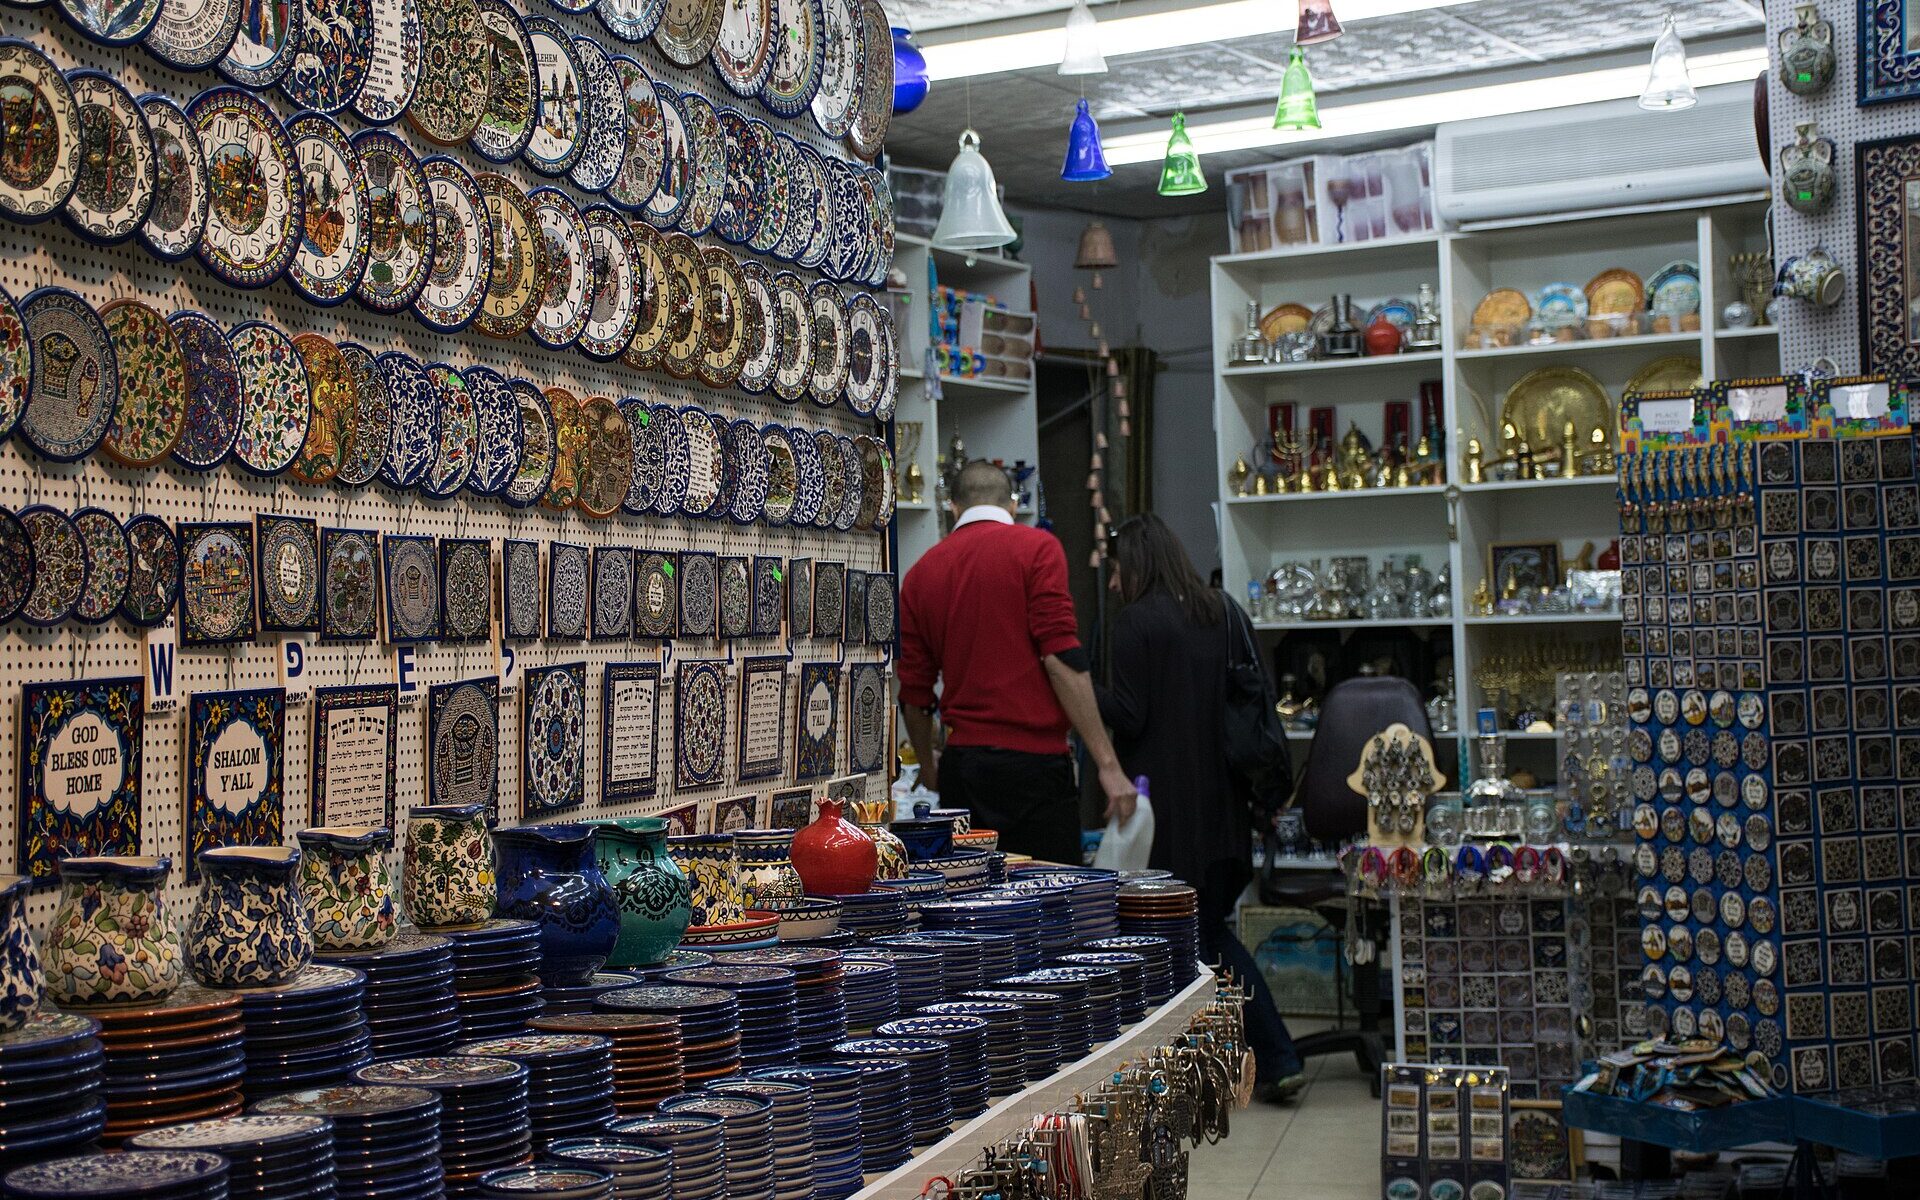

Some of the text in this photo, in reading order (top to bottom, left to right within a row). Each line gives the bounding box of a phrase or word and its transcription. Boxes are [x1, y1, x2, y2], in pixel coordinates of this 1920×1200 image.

[845, 25, 850, 40] 2
[537, 54, 558, 62] LEHEM
[847, 52, 853, 67] 3
[844, 79, 850, 92] 4
[81, 88, 93, 103] 12
[108, 92, 115, 108] 1
[827, 102, 833, 116] 6
[837, 97, 842, 112] 5
[126, 116, 134, 130] 2
[158, 113, 168, 128] 12
[178, 125, 184, 139] 1
[217, 120, 227, 140] 11
[234, 120, 249, 140] 12
[136, 146, 145, 161] 3
[189, 152, 196, 166] 2
[311, 143, 323, 161] 12
[269, 163, 280, 183] 2
[137, 178, 146, 192] 4
[194, 183, 200, 196] 3
[342, 178, 350, 194] 2
[436, 184, 448, 200] 12
[272, 193, 283, 213] 3
[405, 190, 413, 204] 2
[127, 204, 136, 219] 5
[490, 198, 500, 214] 12
[82, 209, 90, 225] 7
[106, 215, 114, 229] 6
[190, 211, 197, 225] 4
[346, 207, 356, 225] 3
[465, 212, 473, 227] 2
[162, 232, 169, 246] 6
[180, 230, 186, 244] 5
[211, 223, 222, 242] 7
[265, 223, 277, 240] 4
[520, 227, 528, 241] 2
[594, 230, 603, 243] 12
[230, 238, 241, 257] 6
[250, 237, 261, 256] 5
[343, 237, 352, 253] 4
[469, 238, 478, 254] 3
[299, 251, 307, 267] 7
[331, 256, 341, 272] 5
[406, 251, 413, 263] 4
[525, 252, 533, 267] 3
[618, 253, 625, 266] 2
[314, 260, 325, 277] 6
[395, 265, 403, 278] 5
[465, 266, 474, 280] 4
[710, 270, 719, 282] 12
[522, 278, 530, 293] 4
[622, 276, 629, 290] 3
[658, 271, 665, 285] 2
[425, 284, 431, 299] 7
[439, 290, 448, 306] 6
[454, 284, 463, 300] 5
[732, 288, 738, 300] 2
[495, 300, 504, 316] 6
[511, 295, 520, 310] 5
[619, 301, 626, 314] 4
[661, 294, 668, 308] 3
[735, 308, 742, 321] 3
[765, 305, 772, 317] 2
[597, 324, 605, 338] 6
[611, 318, 618, 332] 5
[657, 318, 664, 330] 4
[648, 332, 656, 346] 5
[734, 331, 740, 342] 4
[768, 326, 774, 338] 3
[636, 336, 643, 350] 6
[728, 347, 734, 360] 5
[765, 347, 771, 358] 4
[716, 354, 724, 367] 6
[758, 360, 764, 372] 5
[748, 363, 755, 376] 6
[1730, 377, 1784, 388] JERUSALEM
[1831, 374, 1886, 386] JERUSALEM
[1642, 390, 1692, 399] JERUSALEM
[286, 642, 304, 678] פ
[150, 642, 174, 696] W
[398, 646, 416, 692] E
[617, 687, 652, 705] ברכת הבית
[810, 700, 829, 712] SHALOM
[72, 726, 98, 744] GOD
[331, 716, 385, 740] ברכת הבית
[51, 747, 118, 772] BLESS OUR
[214, 747, 260, 769] SHALOM
[66, 774, 102, 795] HOME
[221, 772, 254, 792] Y'ALL
